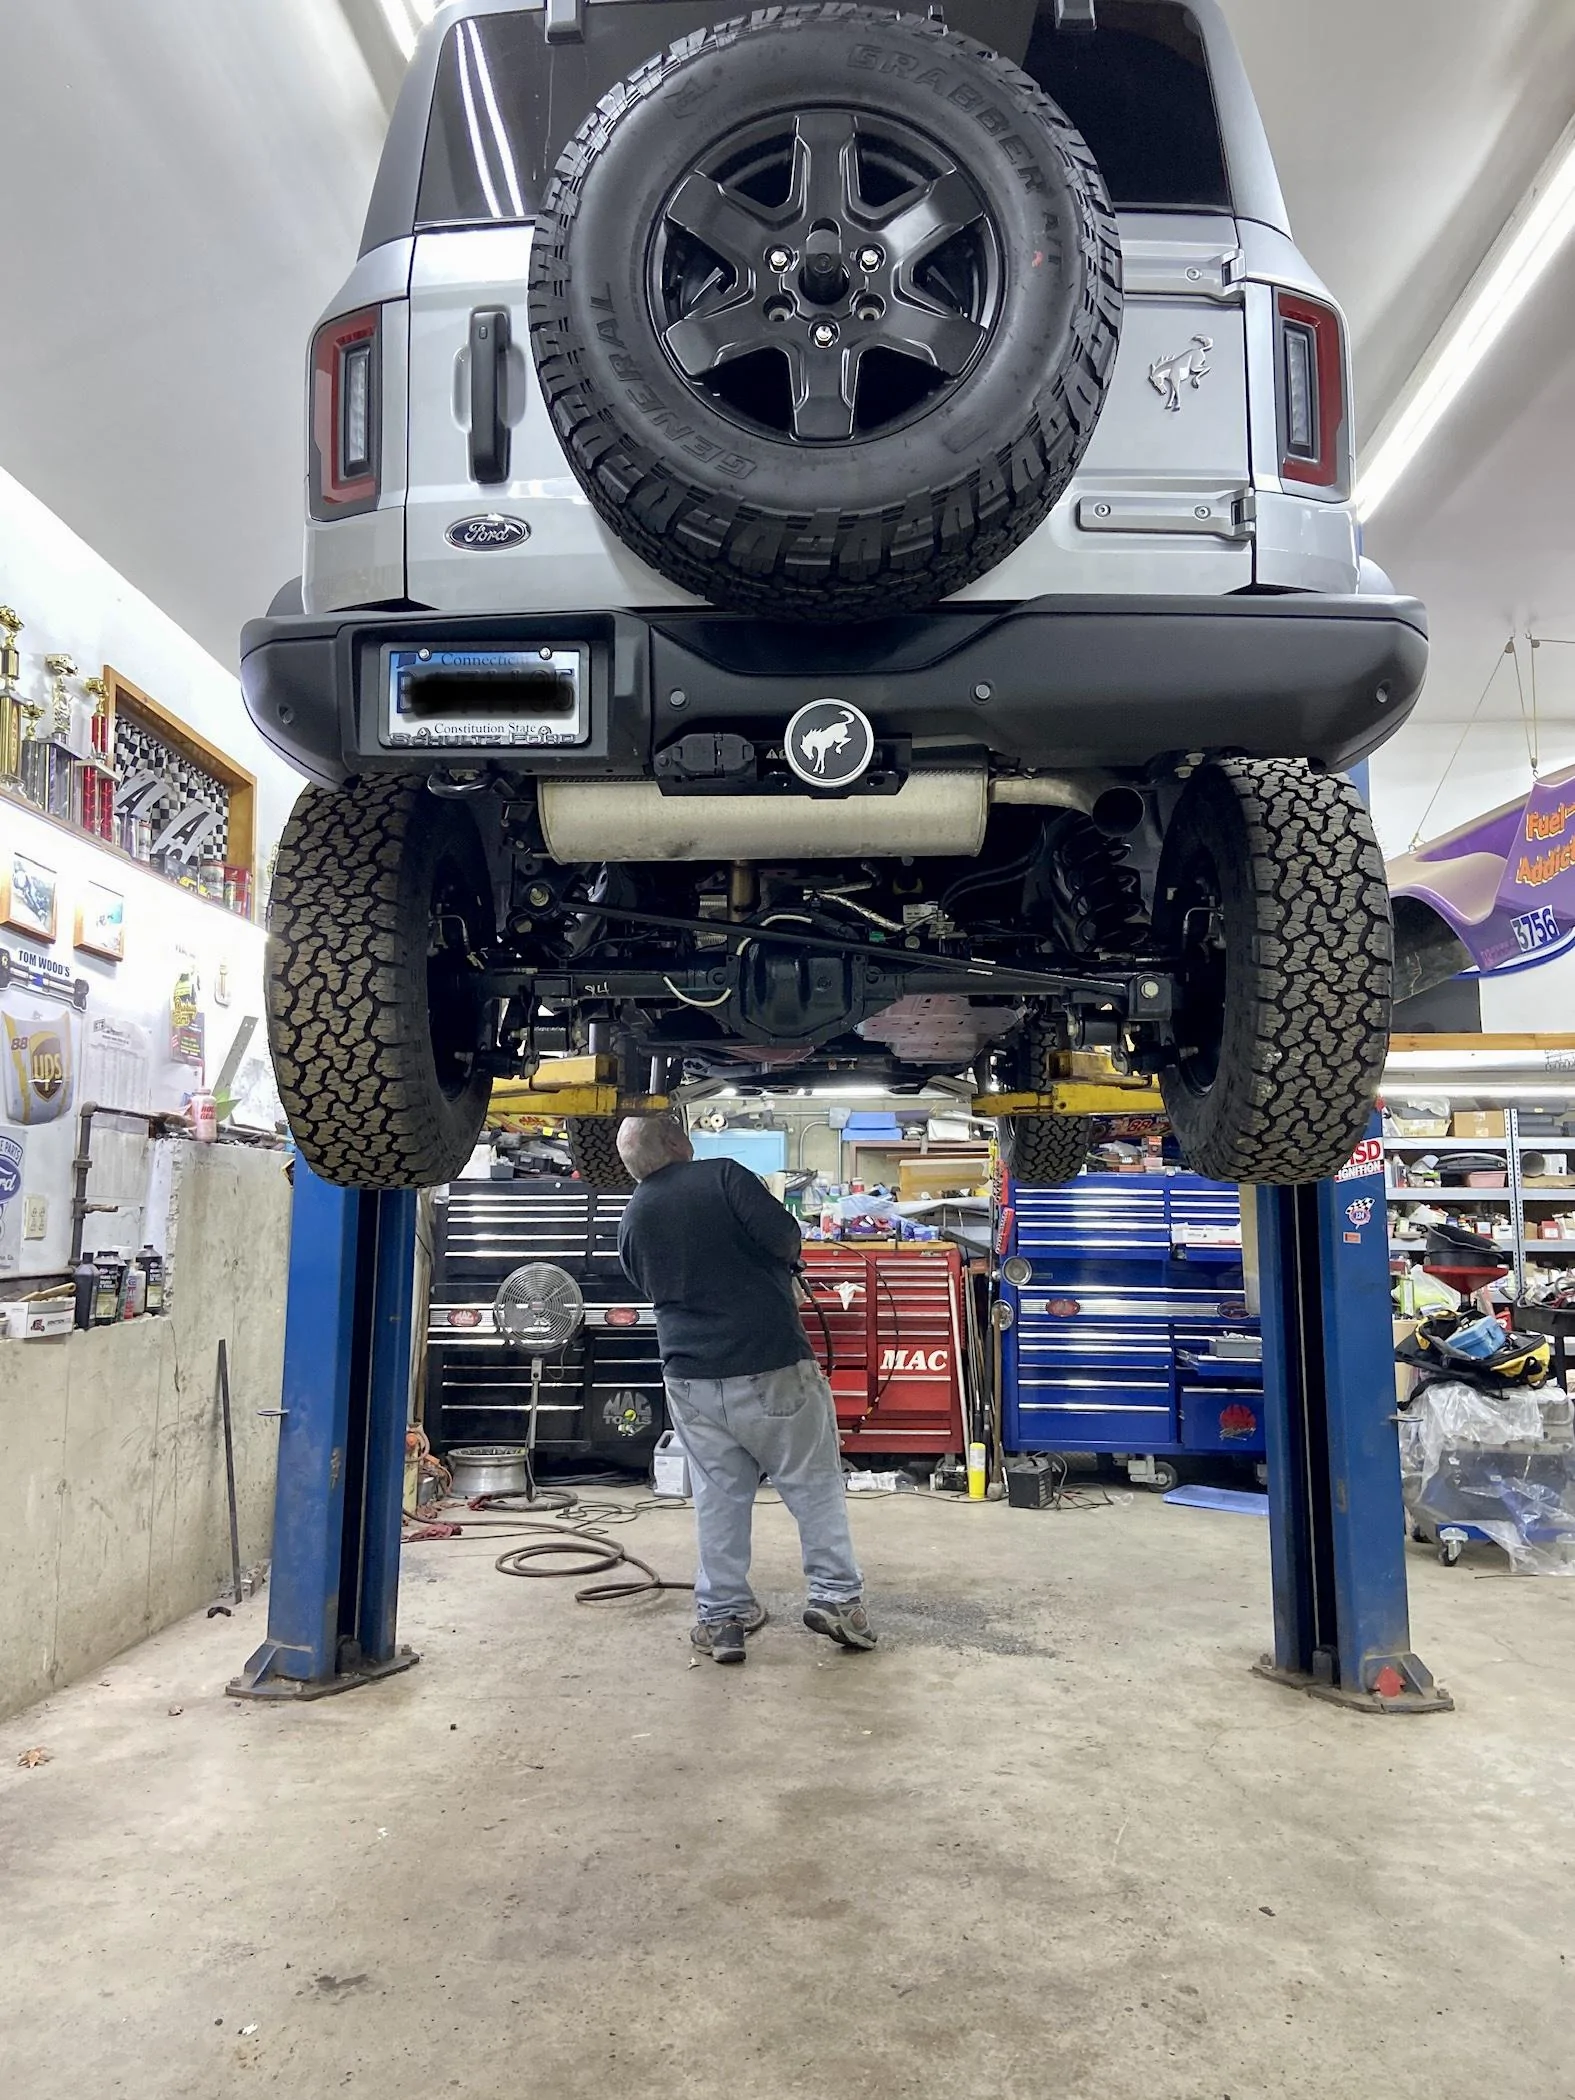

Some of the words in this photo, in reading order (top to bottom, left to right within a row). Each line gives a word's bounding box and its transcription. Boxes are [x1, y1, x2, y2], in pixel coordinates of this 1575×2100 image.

[847, 43, 1049, 195] GRABBER
[590, 282, 758, 480] GENERAL
[464, 521, 510, 544] Ford
[441, 651, 530, 667] Connecticu
[434, 722, 505, 735] Constitution
[508, 721, 537, 735] State
[171, 810, 210, 845] A
[1526, 802, 1566, 842] Fuel
[1511, 907, 1558, 951] 3756
[18, 949, 37, 967] TOM
[38, 955, 70, 978] WOOD'S
[10, 1036, 29, 1051] 88
[4, 1141, 21, 1160] PARTS
[1347, 1140, 1382, 1165] SD
[1338, 1160, 1381, 1181] IGNITION
[879, 1349, 948, 1372] MAC
[603, 1391, 653, 1417] MAC
[603, 1415, 653, 1425] TOLS
